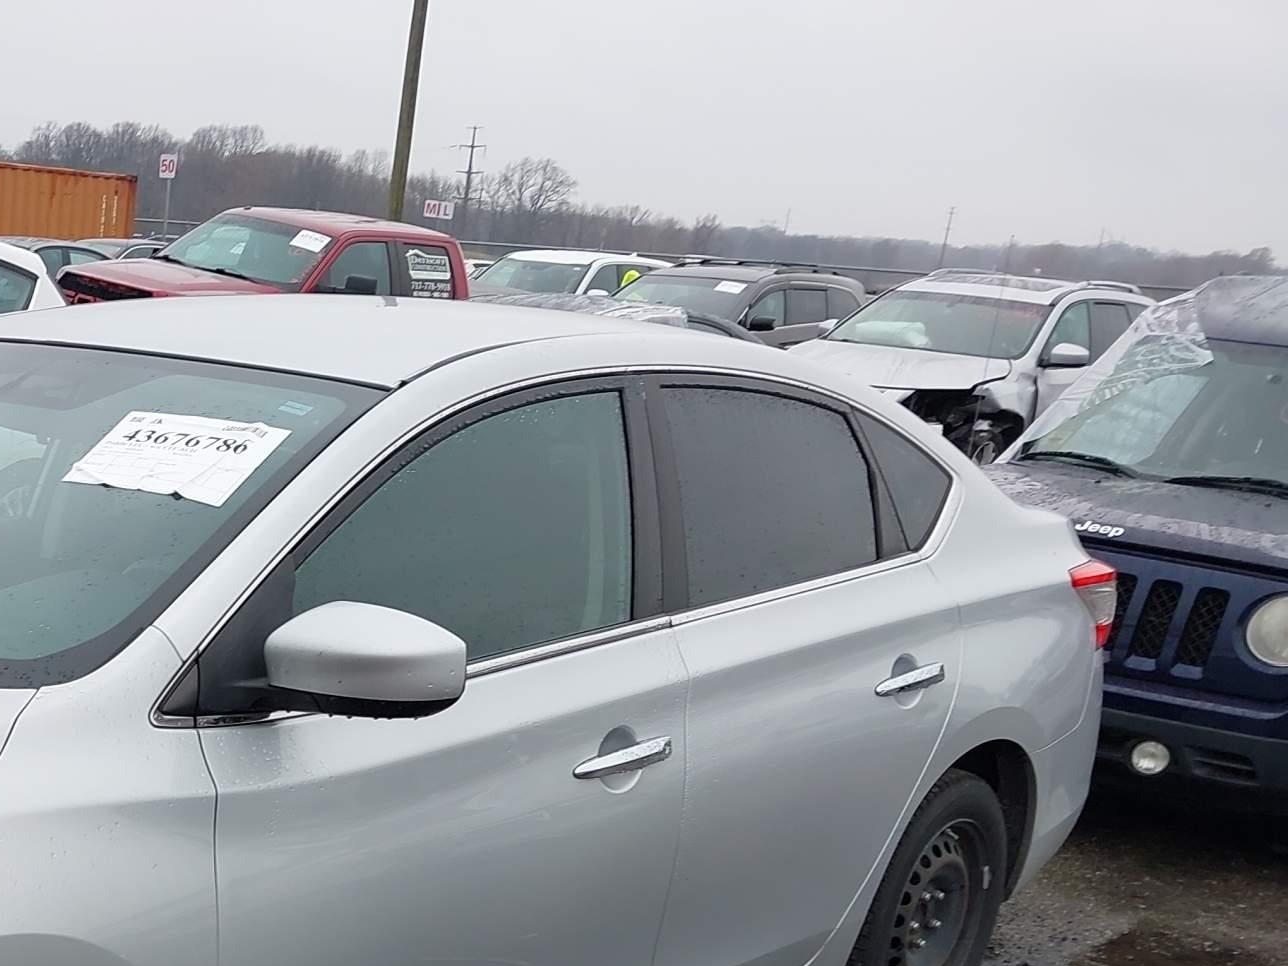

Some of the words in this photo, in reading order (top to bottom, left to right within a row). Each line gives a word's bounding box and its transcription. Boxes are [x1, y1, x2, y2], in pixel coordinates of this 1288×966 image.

[161, 159, 175, 173] 50
[122, 428, 255, 455] 43676786
[1074, 520, 1125, 537] Jeep
